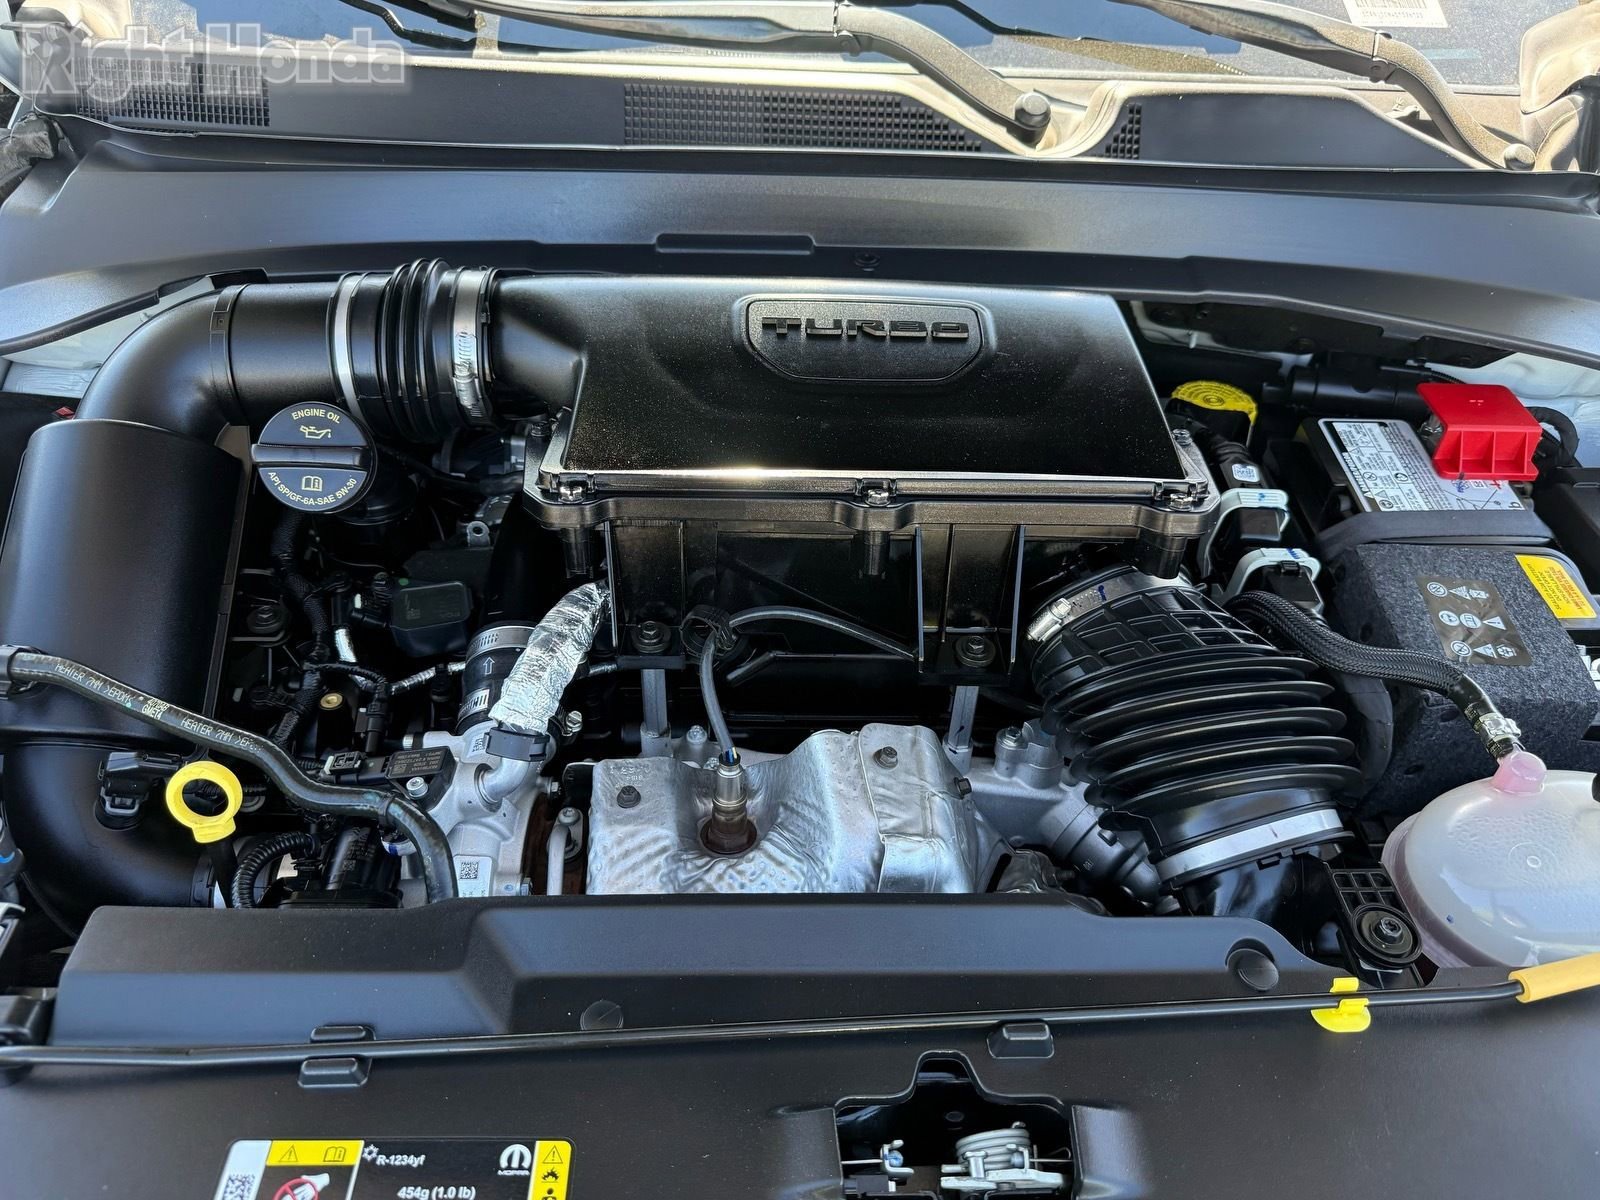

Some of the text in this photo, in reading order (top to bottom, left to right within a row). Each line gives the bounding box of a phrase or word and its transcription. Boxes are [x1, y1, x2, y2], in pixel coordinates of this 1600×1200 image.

[761, 316, 970, 339] TURBO
[291, 408, 341, 424] ENGINE OIL
[267, 471, 282, 489] API
[335, 477, 358, 499] 5W-30
[181, 717, 213, 736] HEATER
[376, 1154, 426, 1167] R-1234yf
[397, 1186, 476, 1200] 454g (1.0 lb)
